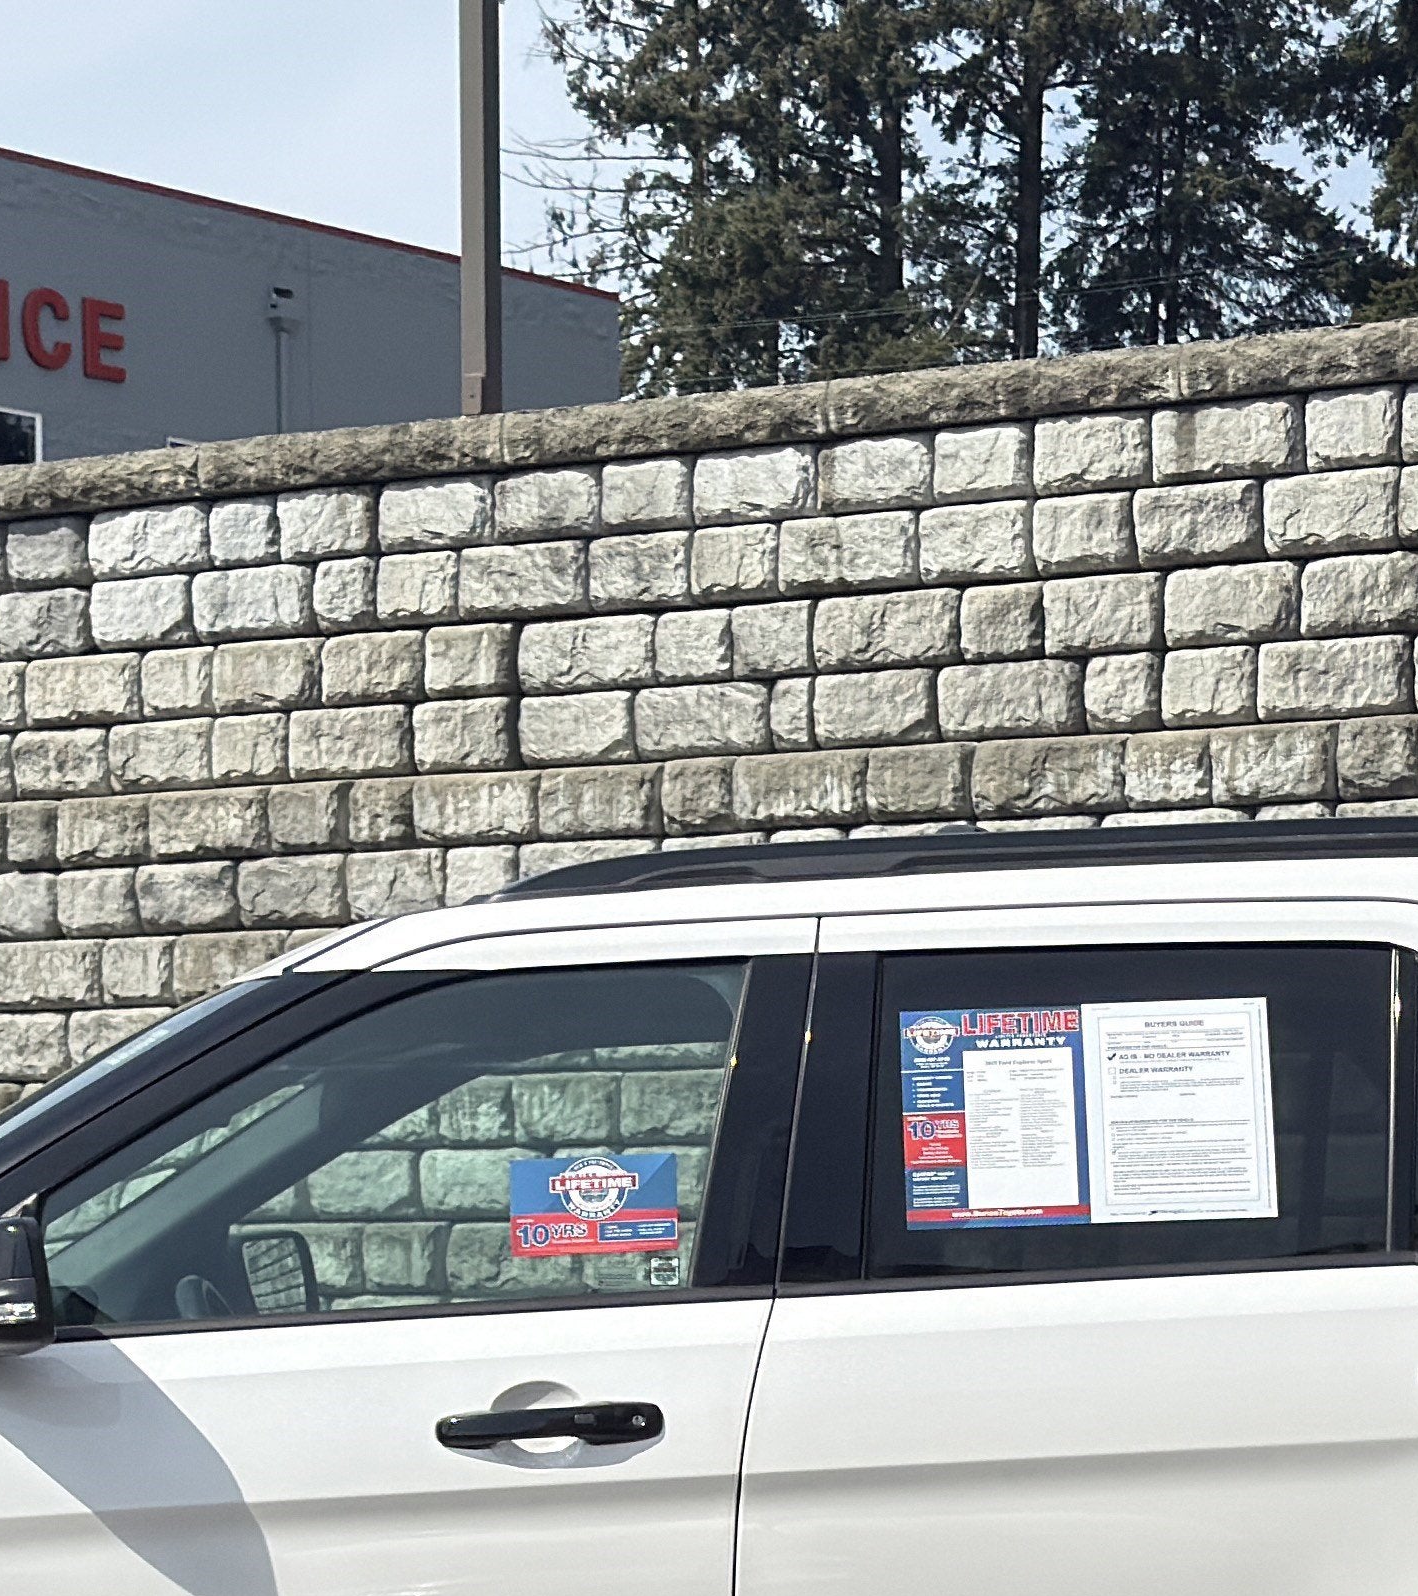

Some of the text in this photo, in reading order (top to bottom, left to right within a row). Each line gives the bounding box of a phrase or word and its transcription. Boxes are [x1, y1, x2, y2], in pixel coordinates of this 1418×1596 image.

[962, 1009, 1079, 1036] LIFETIME
[975, 1036, 1067, 1048] WARRANTY
[907, 1120, 936, 1140] 10
[554, 1176, 632, 1191] LIFETIME
[568, 1199, 622, 1219] WARRANTY
[517, 1223, 550, 1247] 10
[550, 1222, 588, 1239] YRS
